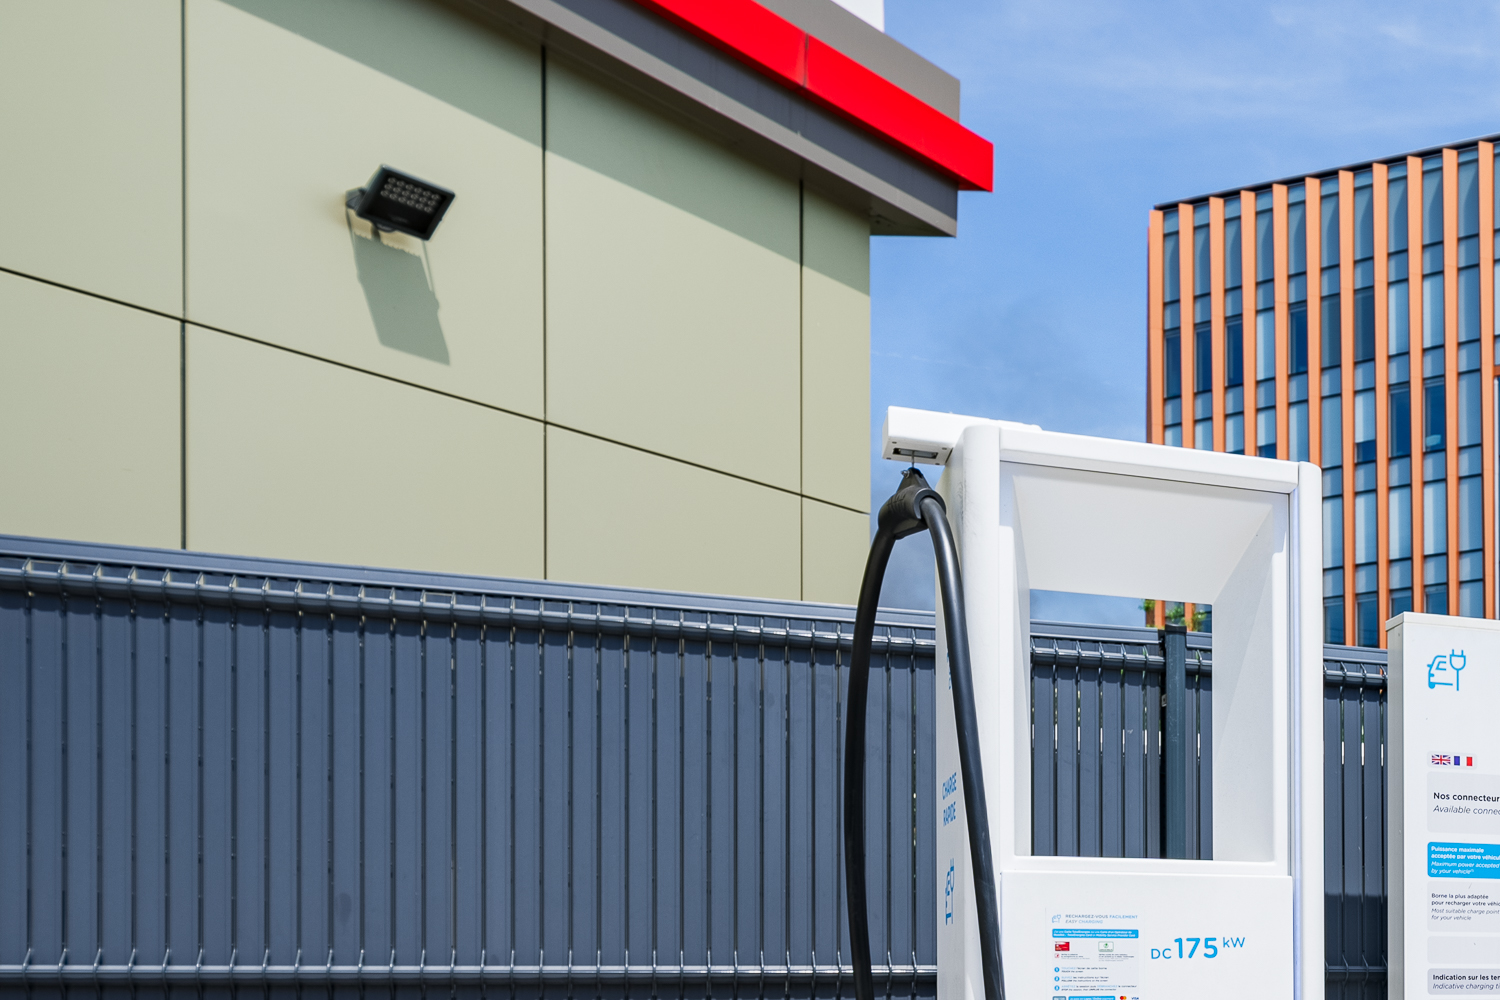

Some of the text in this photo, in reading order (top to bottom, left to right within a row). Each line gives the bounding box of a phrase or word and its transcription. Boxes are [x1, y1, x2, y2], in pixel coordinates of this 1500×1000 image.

[943, 772, 957, 800] CHARGE
[943, 801, 956, 826] RAPIDE
[1433, 805, 1471, 814] Available
[1151, 937, 1245, 959] DC 175 kW
